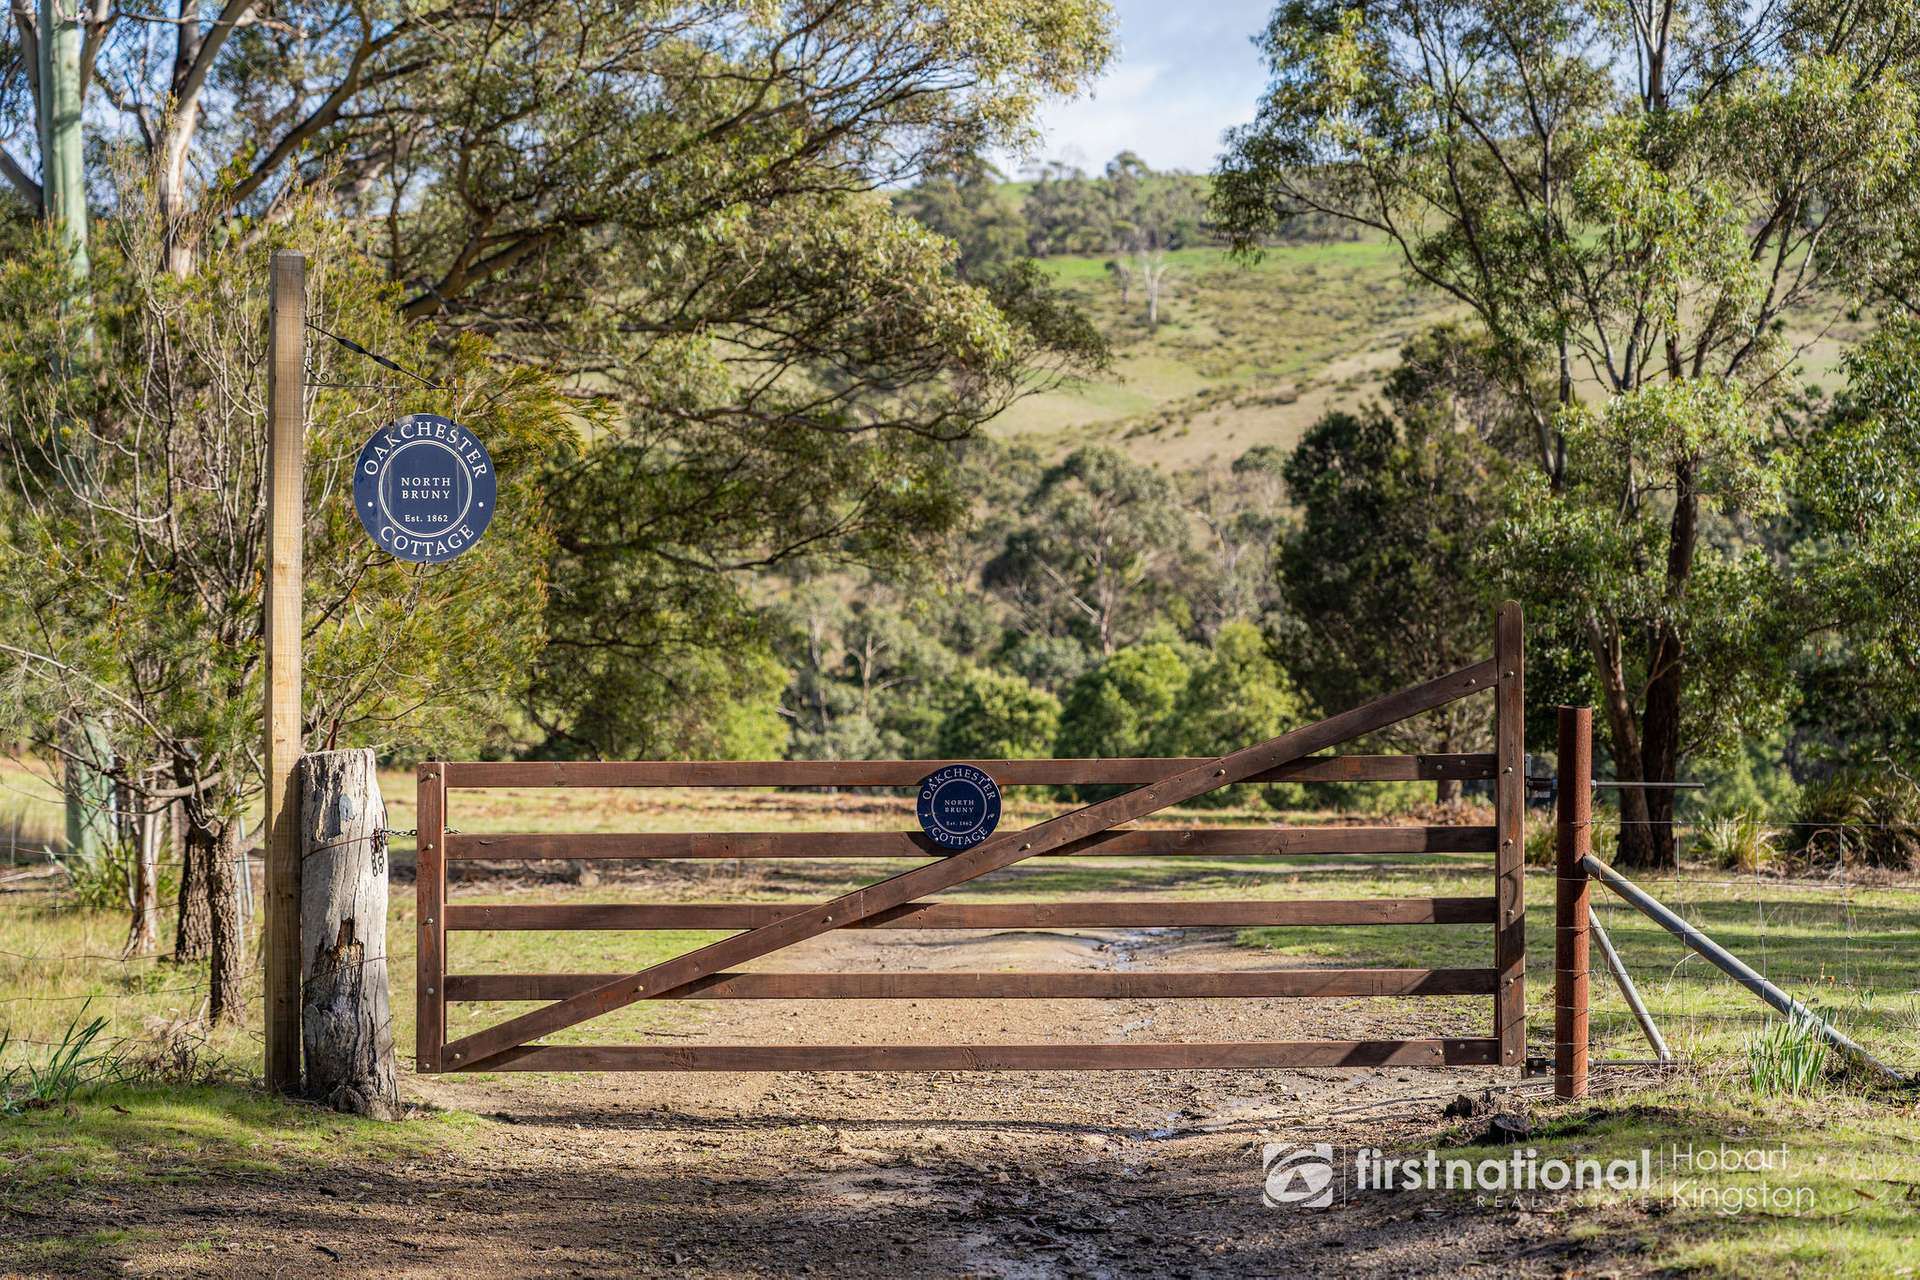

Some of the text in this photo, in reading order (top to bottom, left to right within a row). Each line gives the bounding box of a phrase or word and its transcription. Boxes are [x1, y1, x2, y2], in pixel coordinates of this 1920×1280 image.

[364, 421, 487, 478] OAKCHESTER
[401, 477, 450, 486] NORTH
[402, 490, 450, 499] BRUNY
[404, 514, 448, 523] Est. 1862
[381, 524, 474, 557] COTTAGE
[922, 768, 996, 800] OAKCHESTER
[931, 827, 988, 845] COTTAGE
